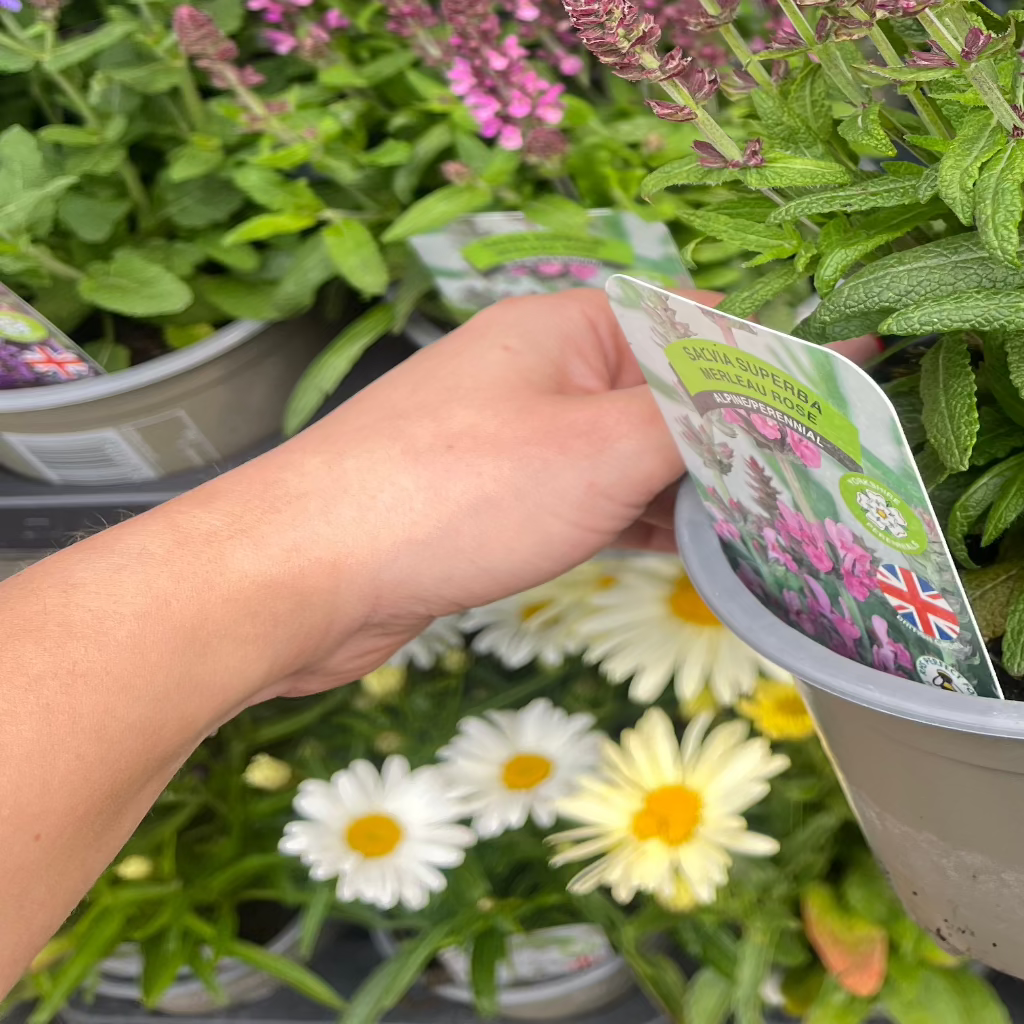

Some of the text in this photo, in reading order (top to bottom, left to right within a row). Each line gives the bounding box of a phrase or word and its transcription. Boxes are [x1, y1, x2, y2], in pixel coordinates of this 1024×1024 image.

[682, 345, 823, 416] SALVIA SUPERBA
[699, 366, 819, 426] MERLEAU ROSE
[712, 392, 825, 448] ALPINE/PERENNIAL
